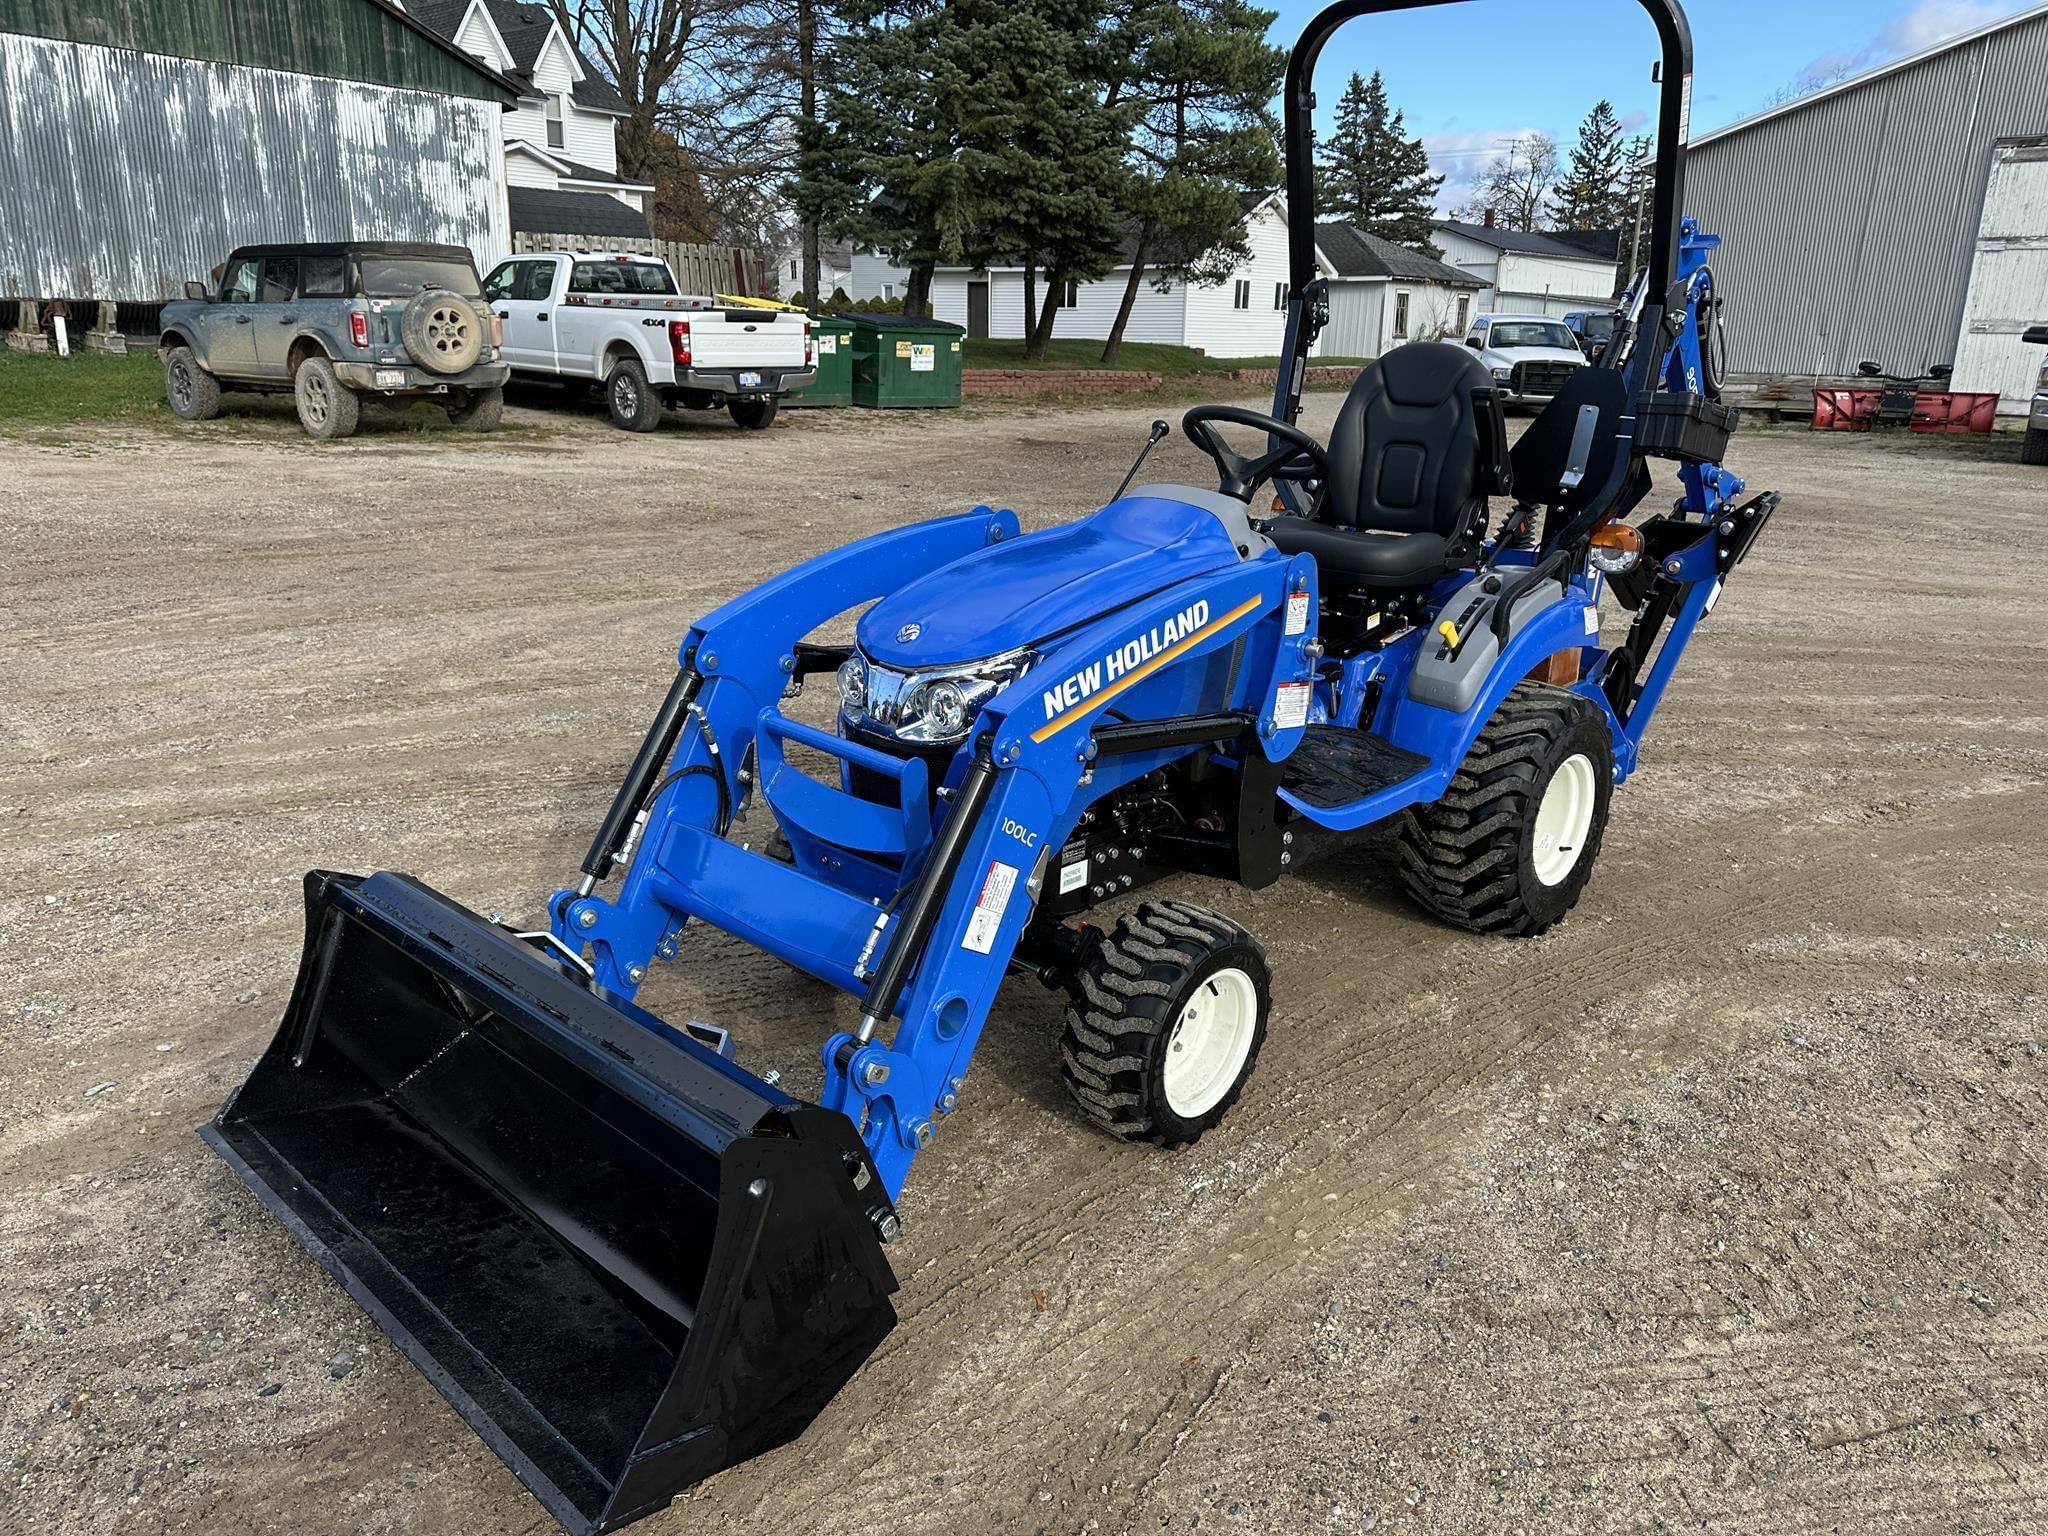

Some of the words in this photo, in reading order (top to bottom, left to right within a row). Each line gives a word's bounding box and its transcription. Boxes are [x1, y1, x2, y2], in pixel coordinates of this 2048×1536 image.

[1043, 660, 1101, 720] NEW
[1105, 599, 1209, 682] HOLLAND
[1001, 816, 1038, 848] 100LC
